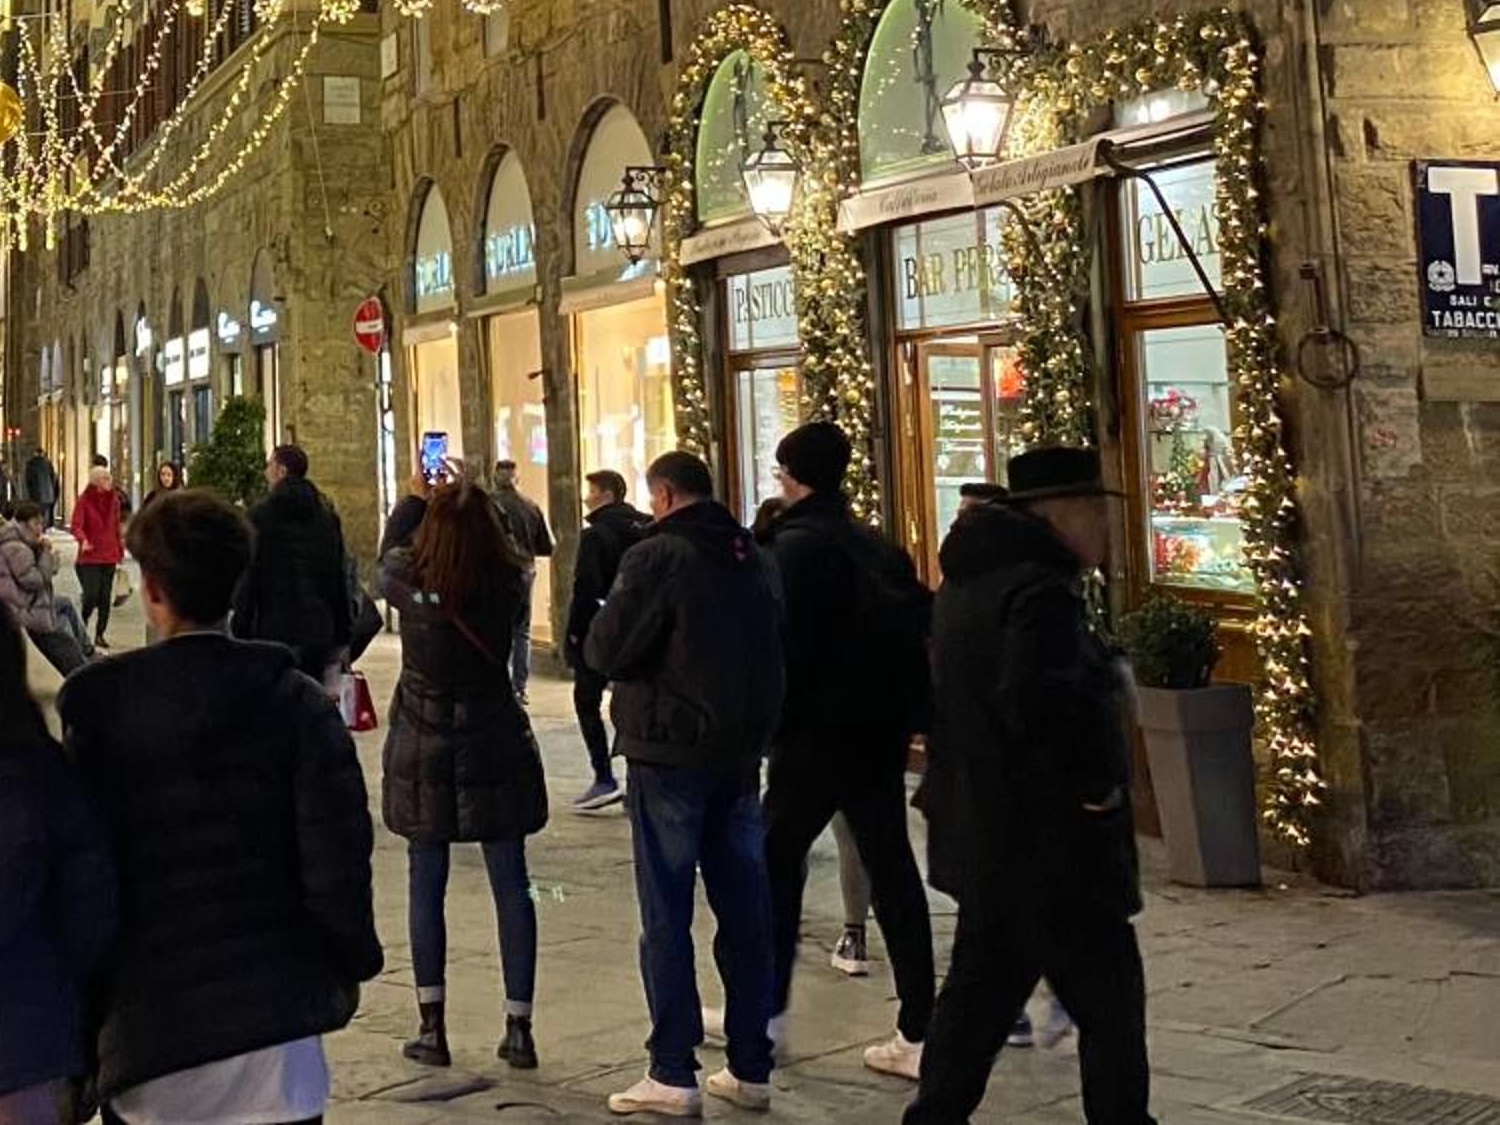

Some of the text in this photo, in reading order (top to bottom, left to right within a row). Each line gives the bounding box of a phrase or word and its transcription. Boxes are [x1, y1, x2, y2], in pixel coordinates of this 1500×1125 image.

[1137, 203, 1220, 264] GELA
[1428, 166, 1499, 285] T
[904, 243, 1009, 300] BAR PERS
[734, 278, 794, 324] PASTICC
[1449, 295, 1477, 306] SALI
